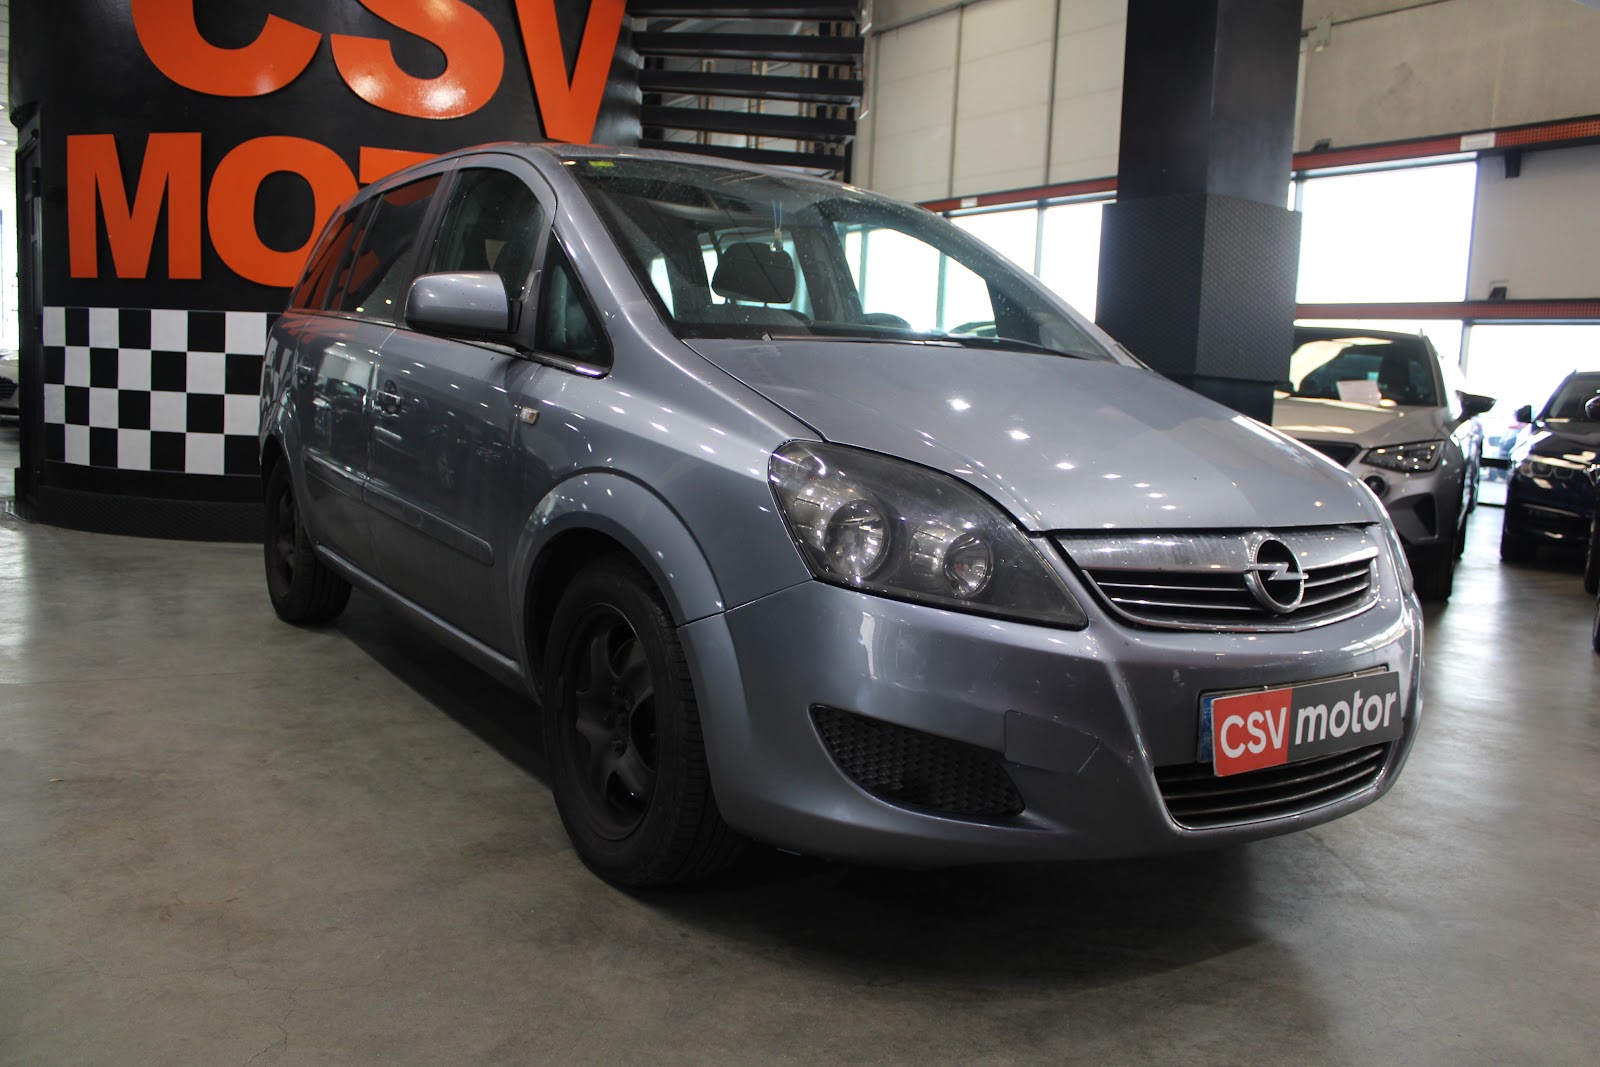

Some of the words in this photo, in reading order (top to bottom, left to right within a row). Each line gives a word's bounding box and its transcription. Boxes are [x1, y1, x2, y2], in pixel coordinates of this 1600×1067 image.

[66, 132, 442, 287] MO
[1221, 707, 1287, 758] CSV
[1295, 690, 1396, 745] motor
